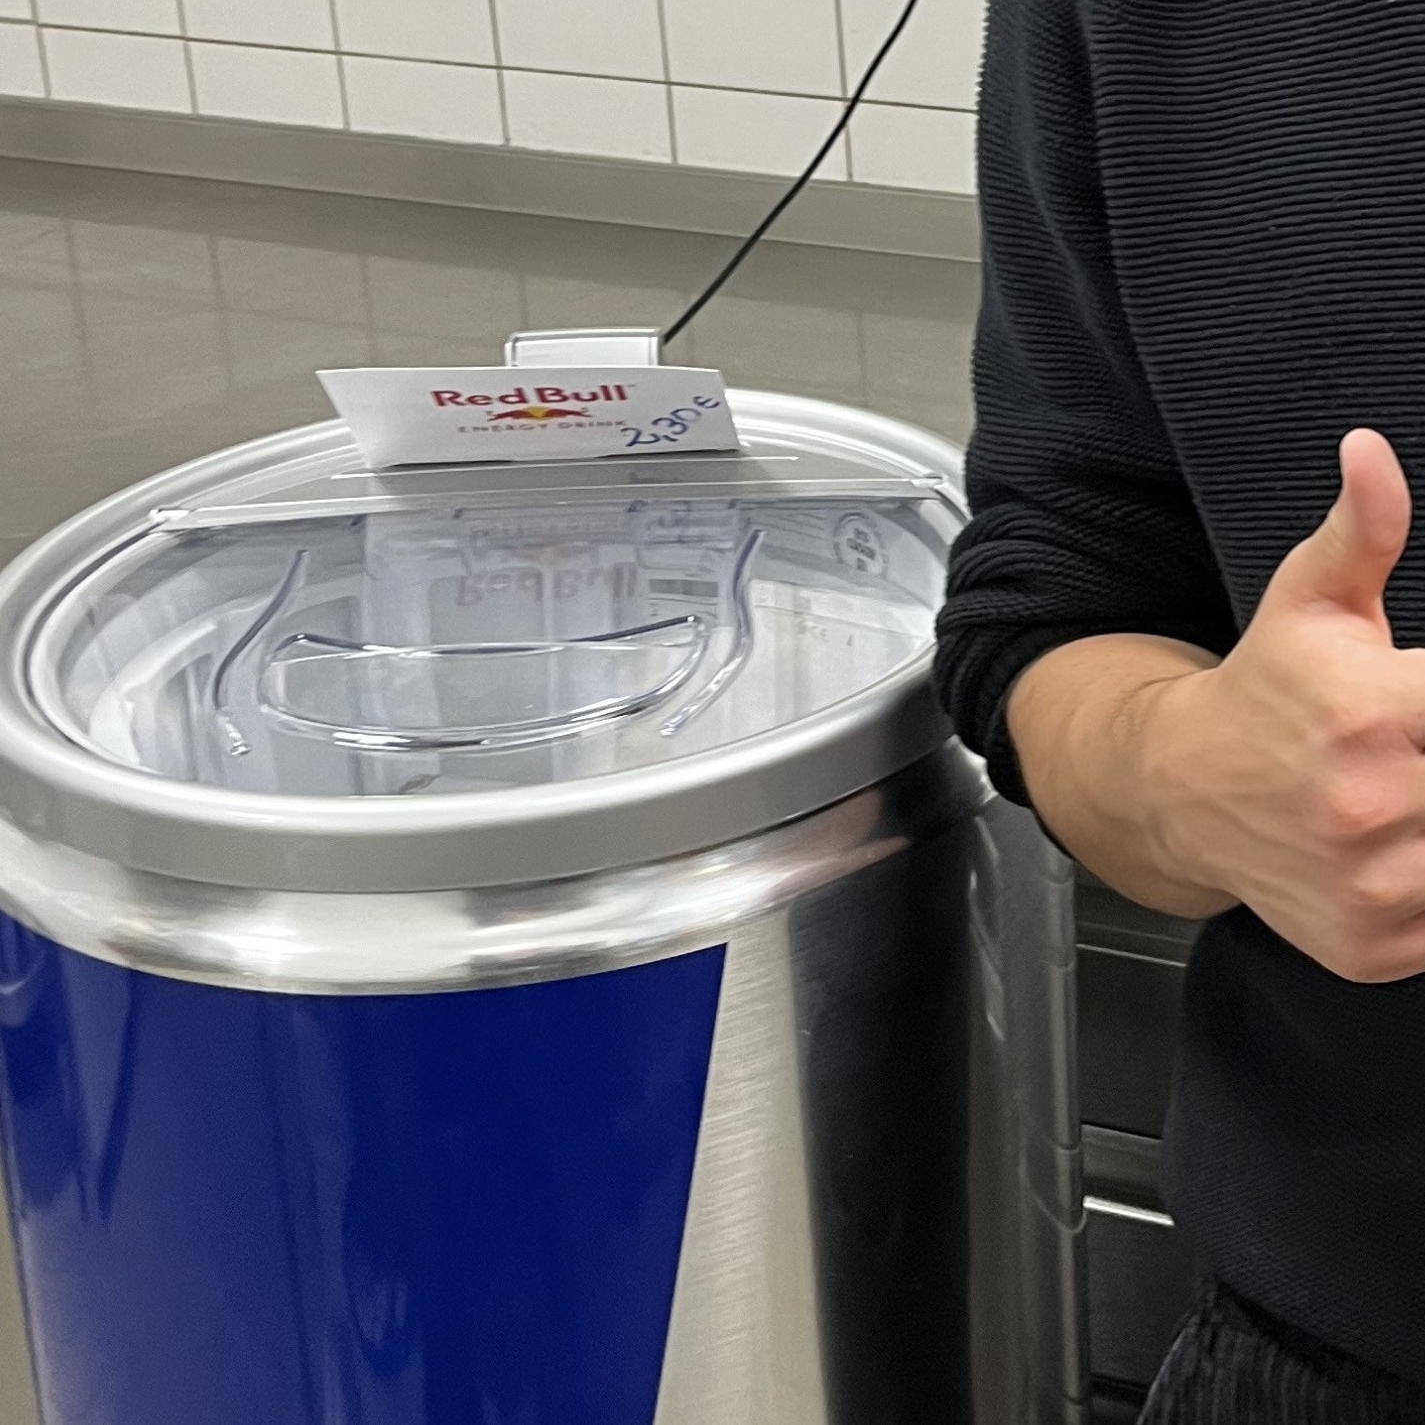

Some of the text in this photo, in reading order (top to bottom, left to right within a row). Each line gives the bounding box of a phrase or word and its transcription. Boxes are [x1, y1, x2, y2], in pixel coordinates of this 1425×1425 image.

[430, 384, 629, 407] Red Bull
[458, 420, 628, 433] ENERGY DRINK
